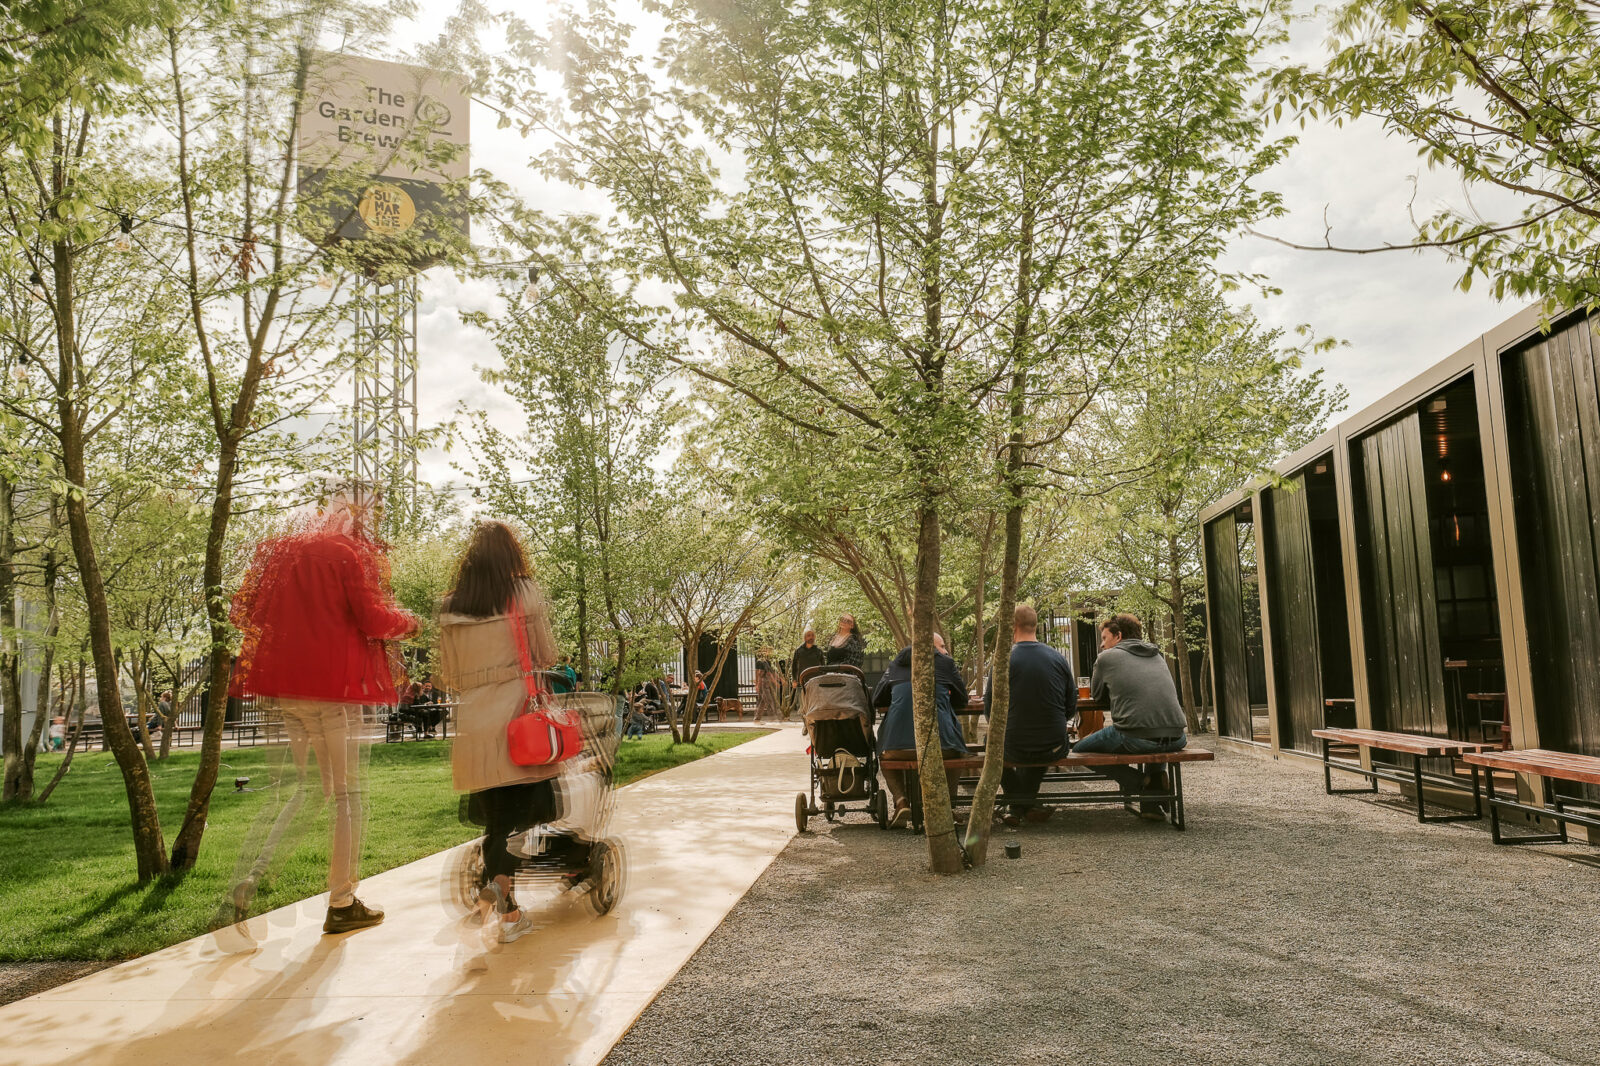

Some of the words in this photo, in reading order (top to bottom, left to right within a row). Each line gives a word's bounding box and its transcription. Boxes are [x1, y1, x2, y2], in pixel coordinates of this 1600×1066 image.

[366, 87, 405, 108] The
[319, 101, 405, 128] Garden
[375, 190, 399, 203] SU
[375, 201, 400, 215] MAR
